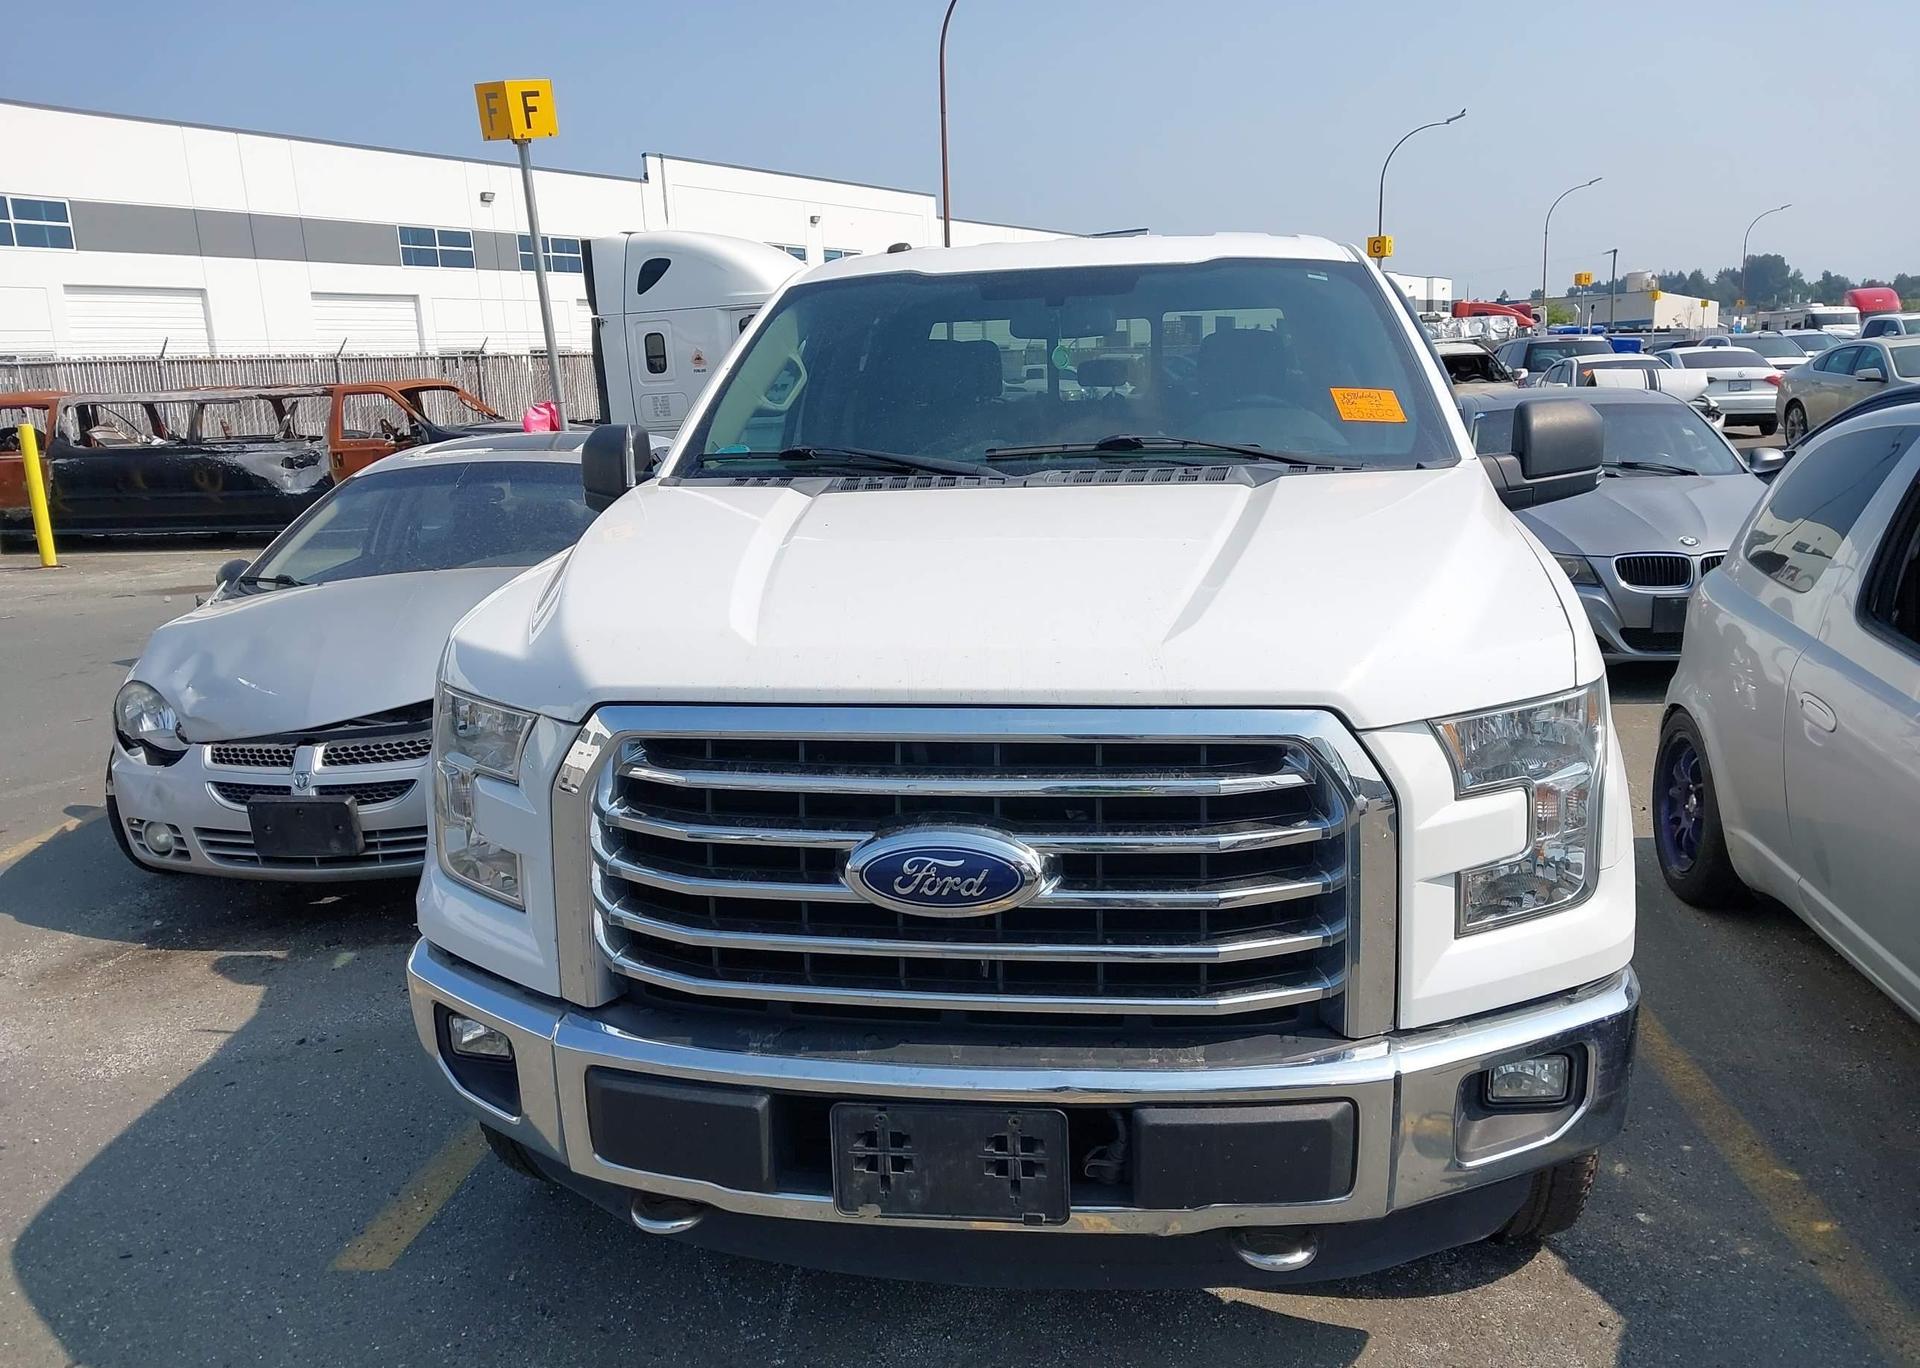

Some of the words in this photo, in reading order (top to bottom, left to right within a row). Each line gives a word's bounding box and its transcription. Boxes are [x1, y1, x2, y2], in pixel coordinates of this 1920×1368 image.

[485, 92, 498, 131] F
[521, 90, 540, 129] F
[1373, 239, 1381, 253] G
[1584, 273, 1590, 284] H
[893, 856, 989, 897] Ford
